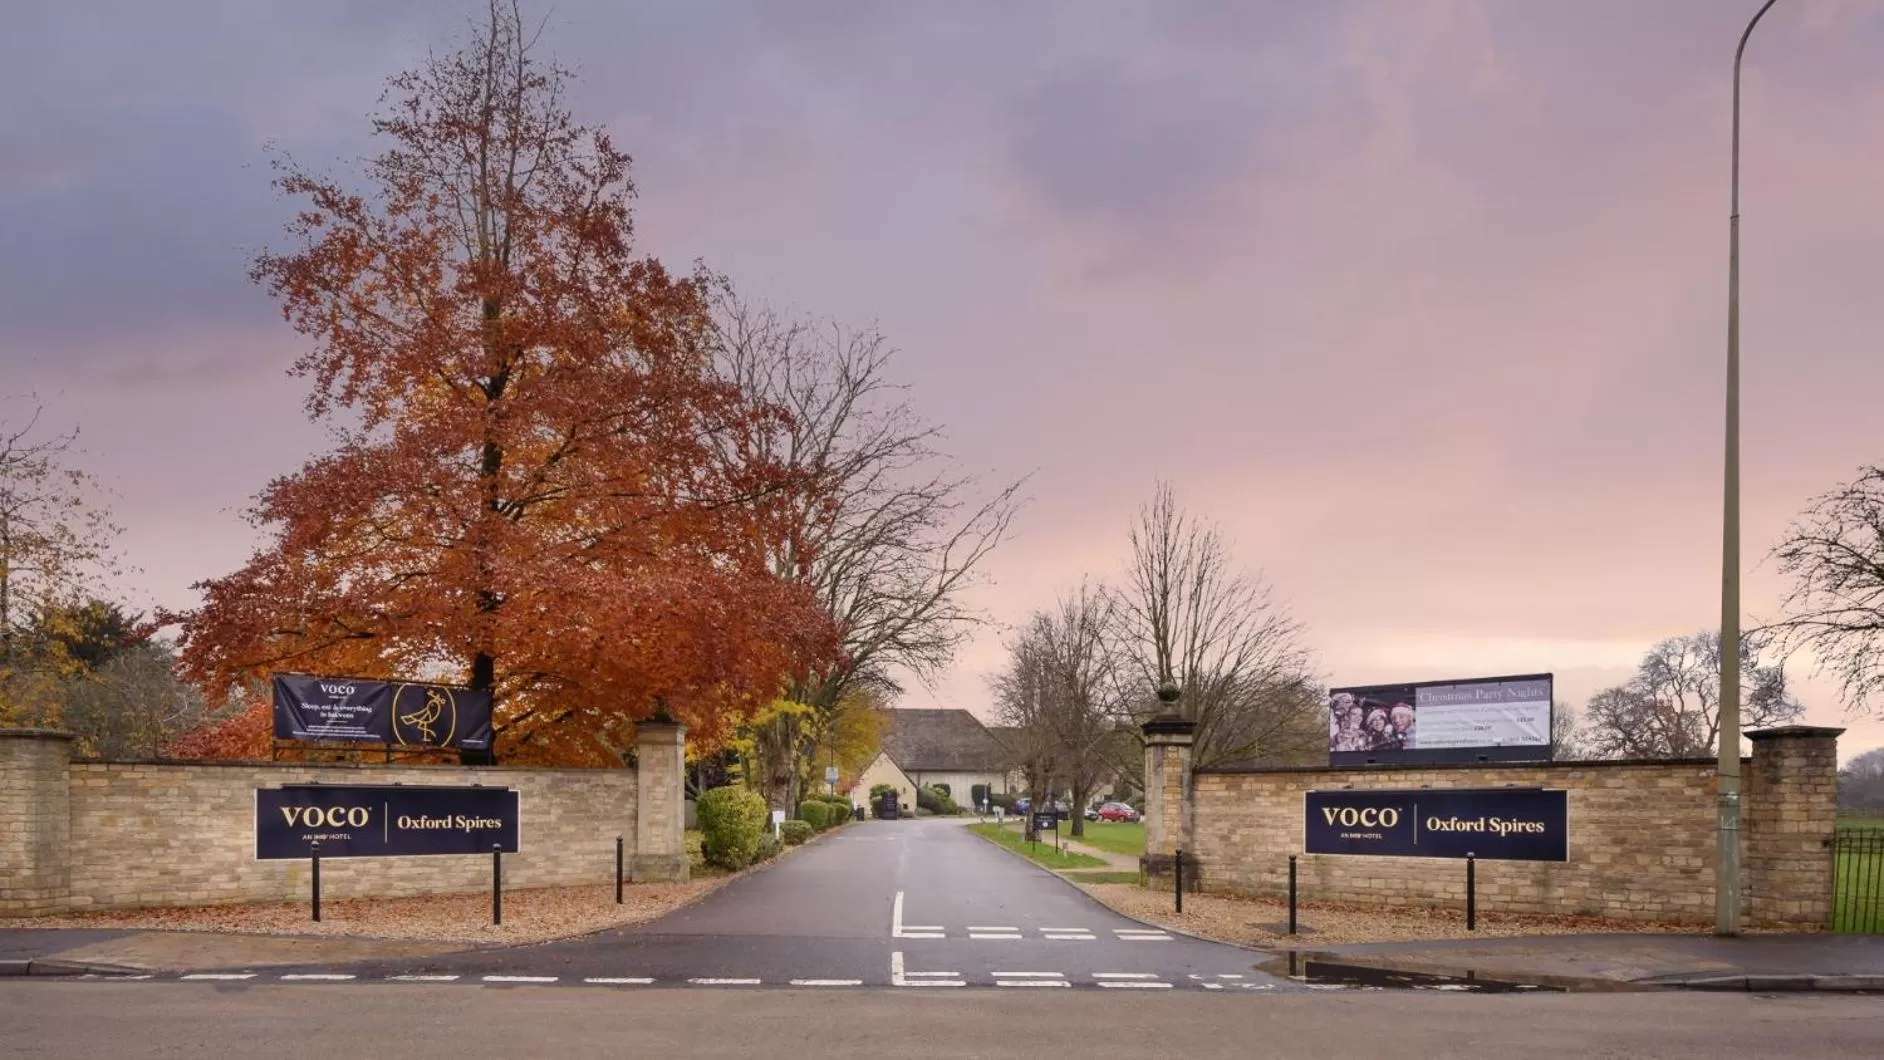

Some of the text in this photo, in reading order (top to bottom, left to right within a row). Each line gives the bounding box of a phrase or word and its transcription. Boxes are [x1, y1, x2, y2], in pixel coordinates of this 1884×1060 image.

[1477, 688, 1502, 701] Party
[397, 815, 503, 833] Oxford Spires
[1426, 816, 1546, 837] Oxford Spires
[329, 833, 352, 841] HOTEL
